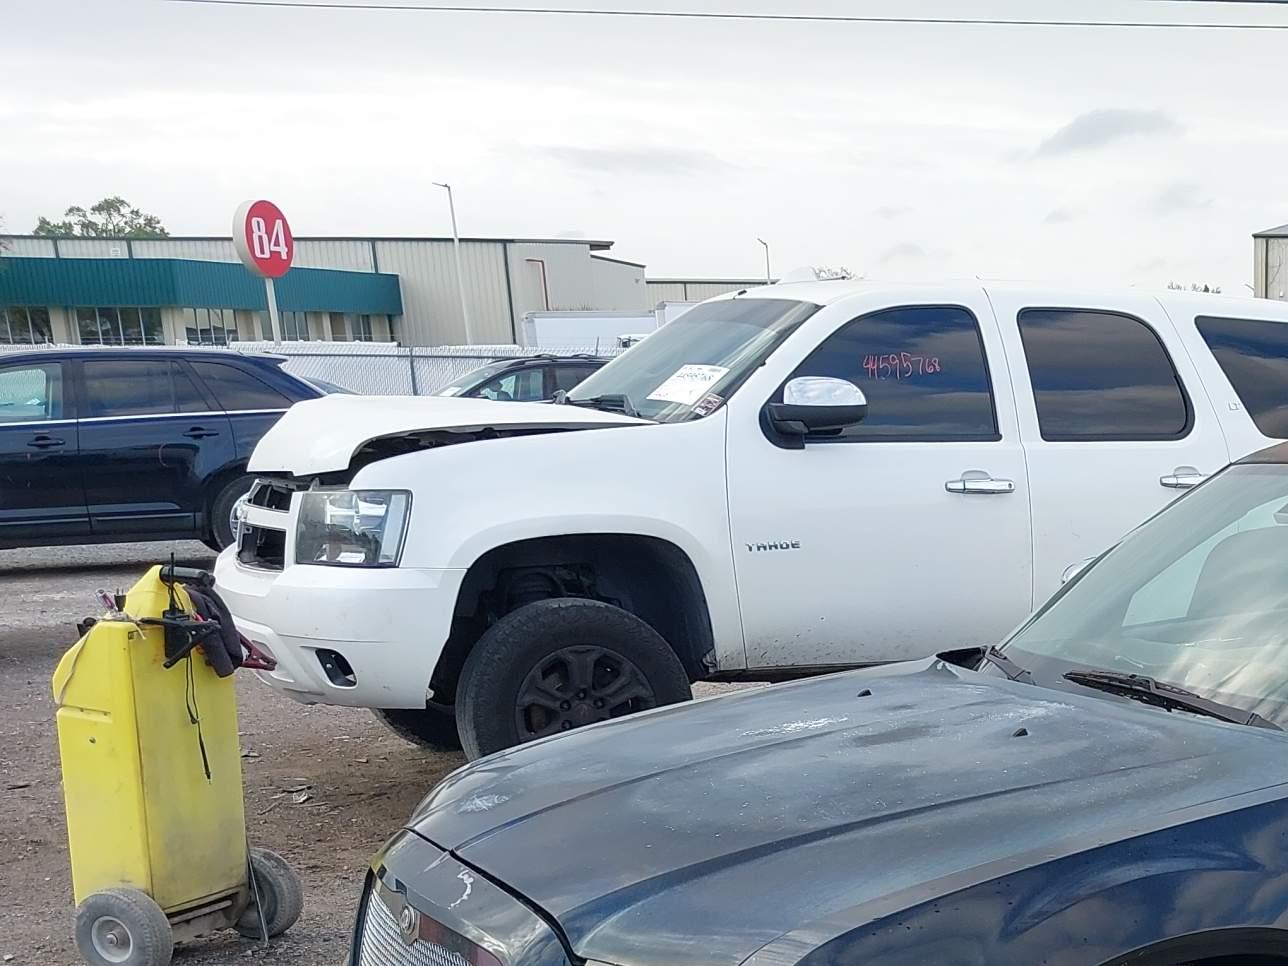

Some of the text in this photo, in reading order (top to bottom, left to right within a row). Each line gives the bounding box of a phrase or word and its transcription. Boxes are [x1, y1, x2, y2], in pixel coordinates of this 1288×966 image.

[251, 217, 288, 260] 84
[863, 352, 940, 380] 44595768
[745, 540, 801, 552] TAHOE
